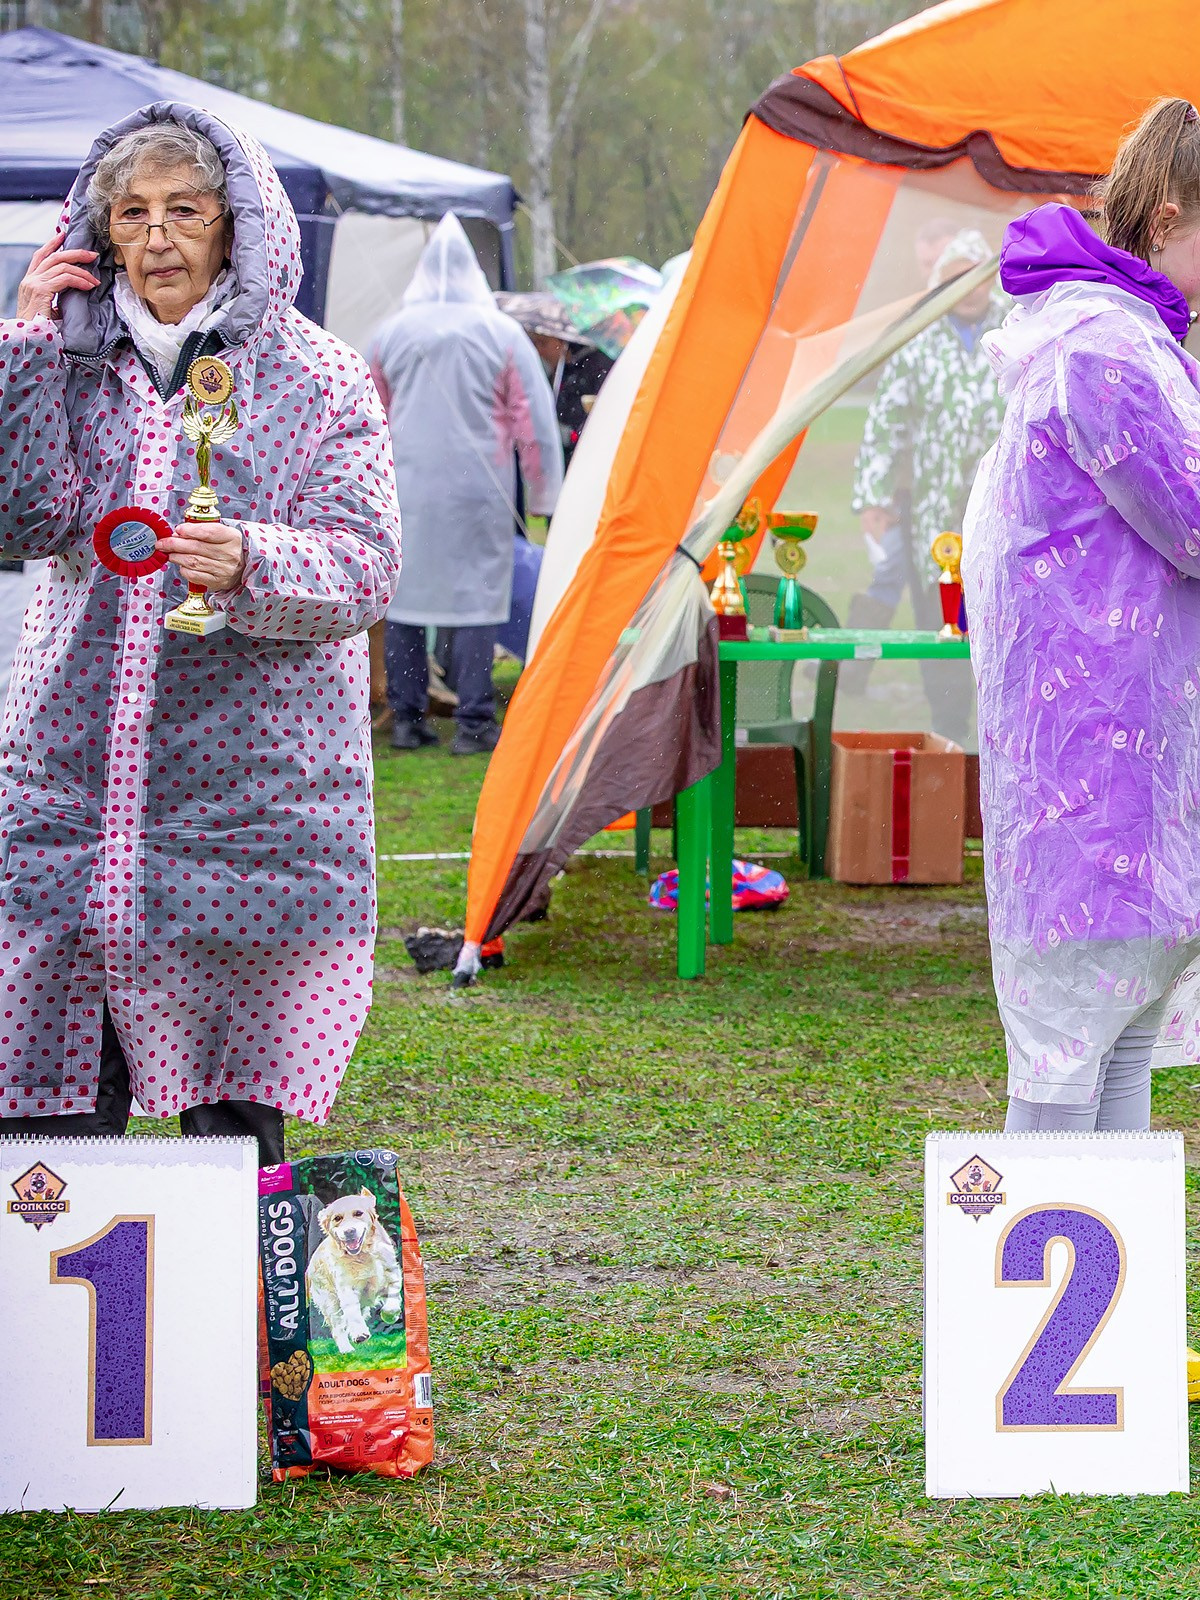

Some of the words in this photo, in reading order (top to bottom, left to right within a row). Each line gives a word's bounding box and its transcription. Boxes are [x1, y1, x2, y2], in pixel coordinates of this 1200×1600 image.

[128, 544, 152, 561] БРИЗ
[12, 1203, 65, 1211] ООПККСС
[951, 1194, 1002, 1203] ООПККСС
[268, 1200, 297, 1277] DOGS
[278, 1280, 299, 1330] ALL
[994, 1202, 1127, 1433] 2
[50, 1214, 155, 1446] 1
[318, 1380, 345, 1389] ADULT
[346, 1378, 370, 1387] DOGS
